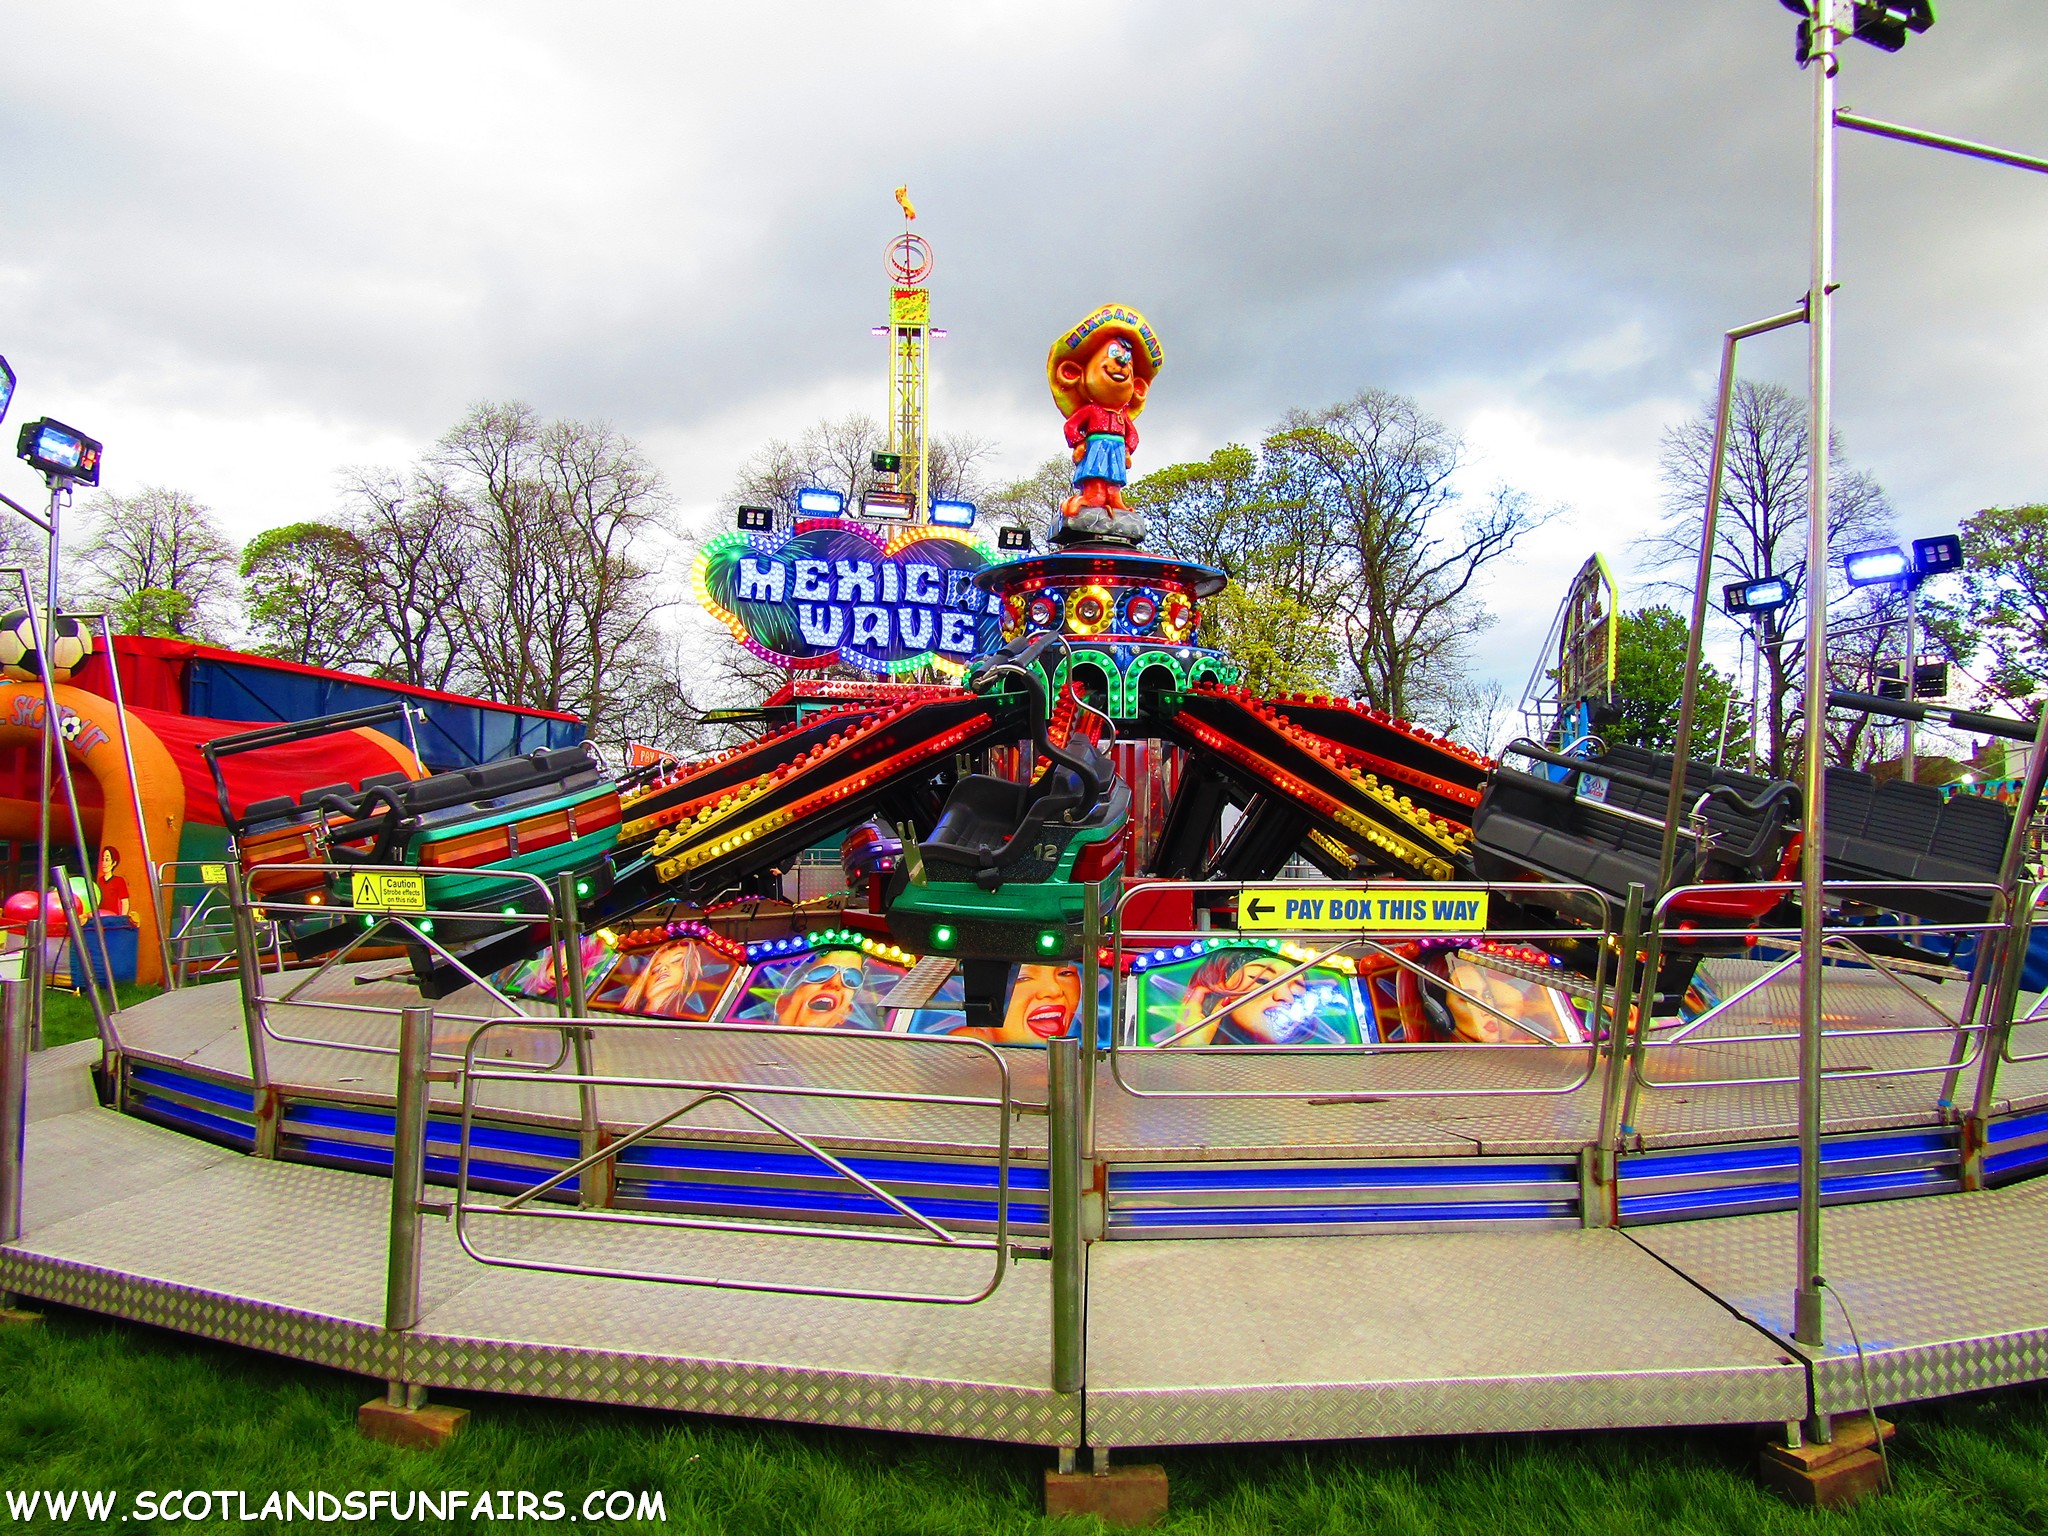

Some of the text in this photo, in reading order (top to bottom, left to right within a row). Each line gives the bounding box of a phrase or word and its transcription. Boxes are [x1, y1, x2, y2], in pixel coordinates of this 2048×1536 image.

[1065, 308, 1163, 367] MEXICAN WAVE
[798, 603, 976, 654] WAVE
[640, 751, 655, 763] PAY
[1033, 843, 1057, 862] 12
[387, 879, 416, 888] Caution
[395, 896, 406, 904] this
[826, 900, 841, 910] 24
[740, 904, 751, 914] 23
[1286, 899, 1480, 921] PAY BOX THIS WAY
